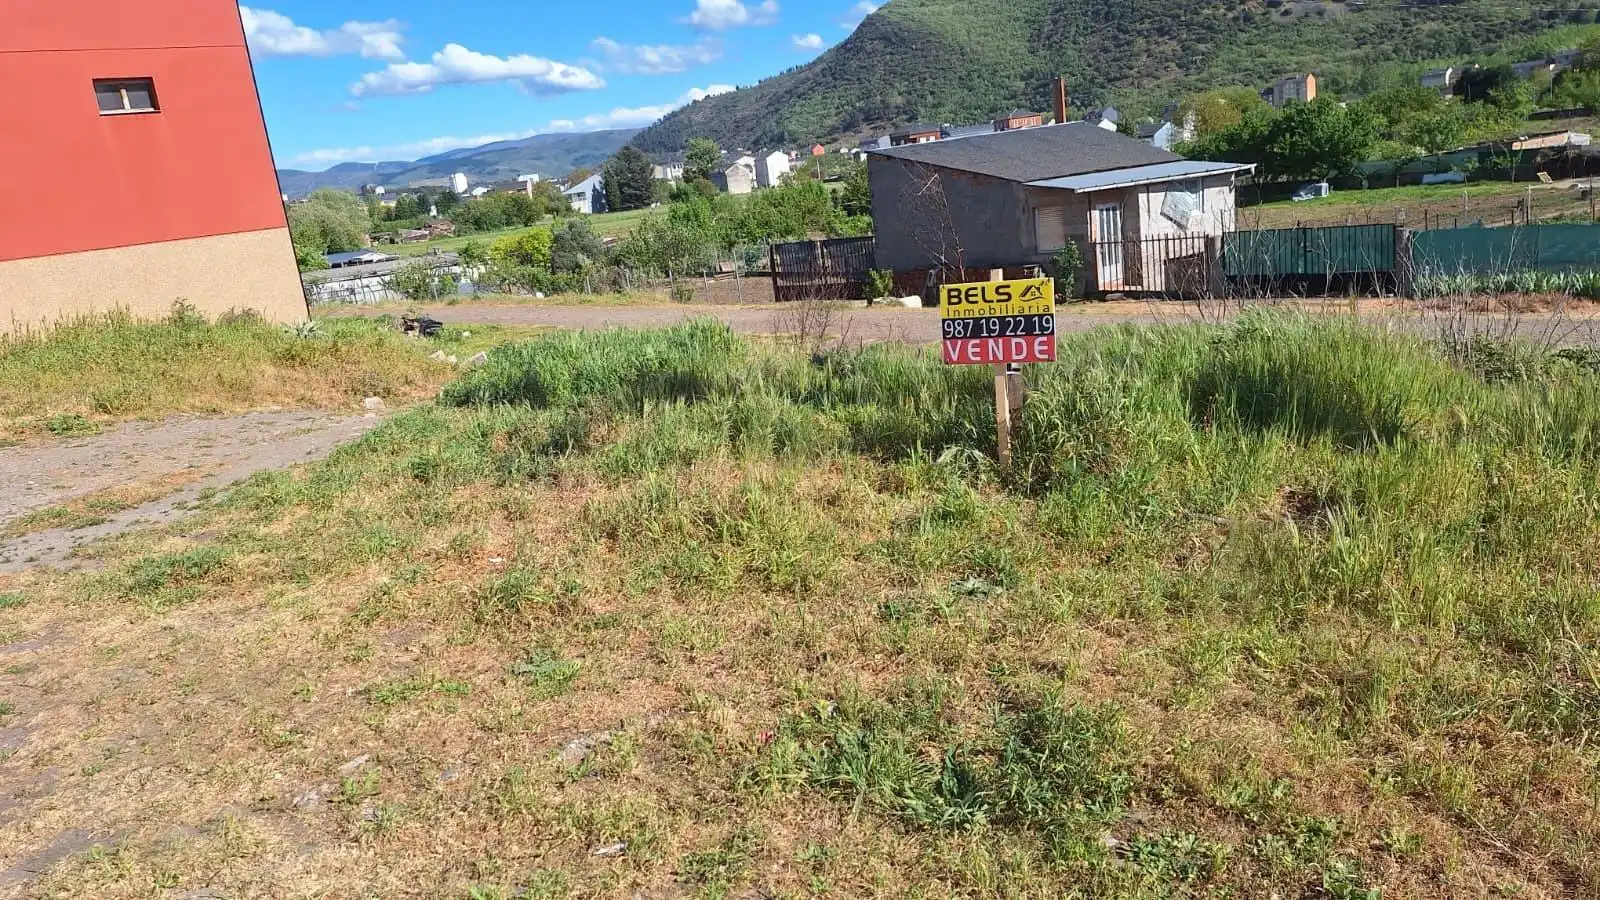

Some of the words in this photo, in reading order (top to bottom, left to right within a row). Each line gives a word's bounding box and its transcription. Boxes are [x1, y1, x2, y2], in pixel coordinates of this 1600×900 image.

[947, 285, 1012, 305] BELS
[947, 303, 1050, 317] Inmobiliaria
[945, 320, 973, 338] 987
[980, 318, 999, 336] 19
[1005, 317, 1025, 335] 22
[1032, 315, 1053, 334] 19
[946, 336, 1049, 361] VENDE
